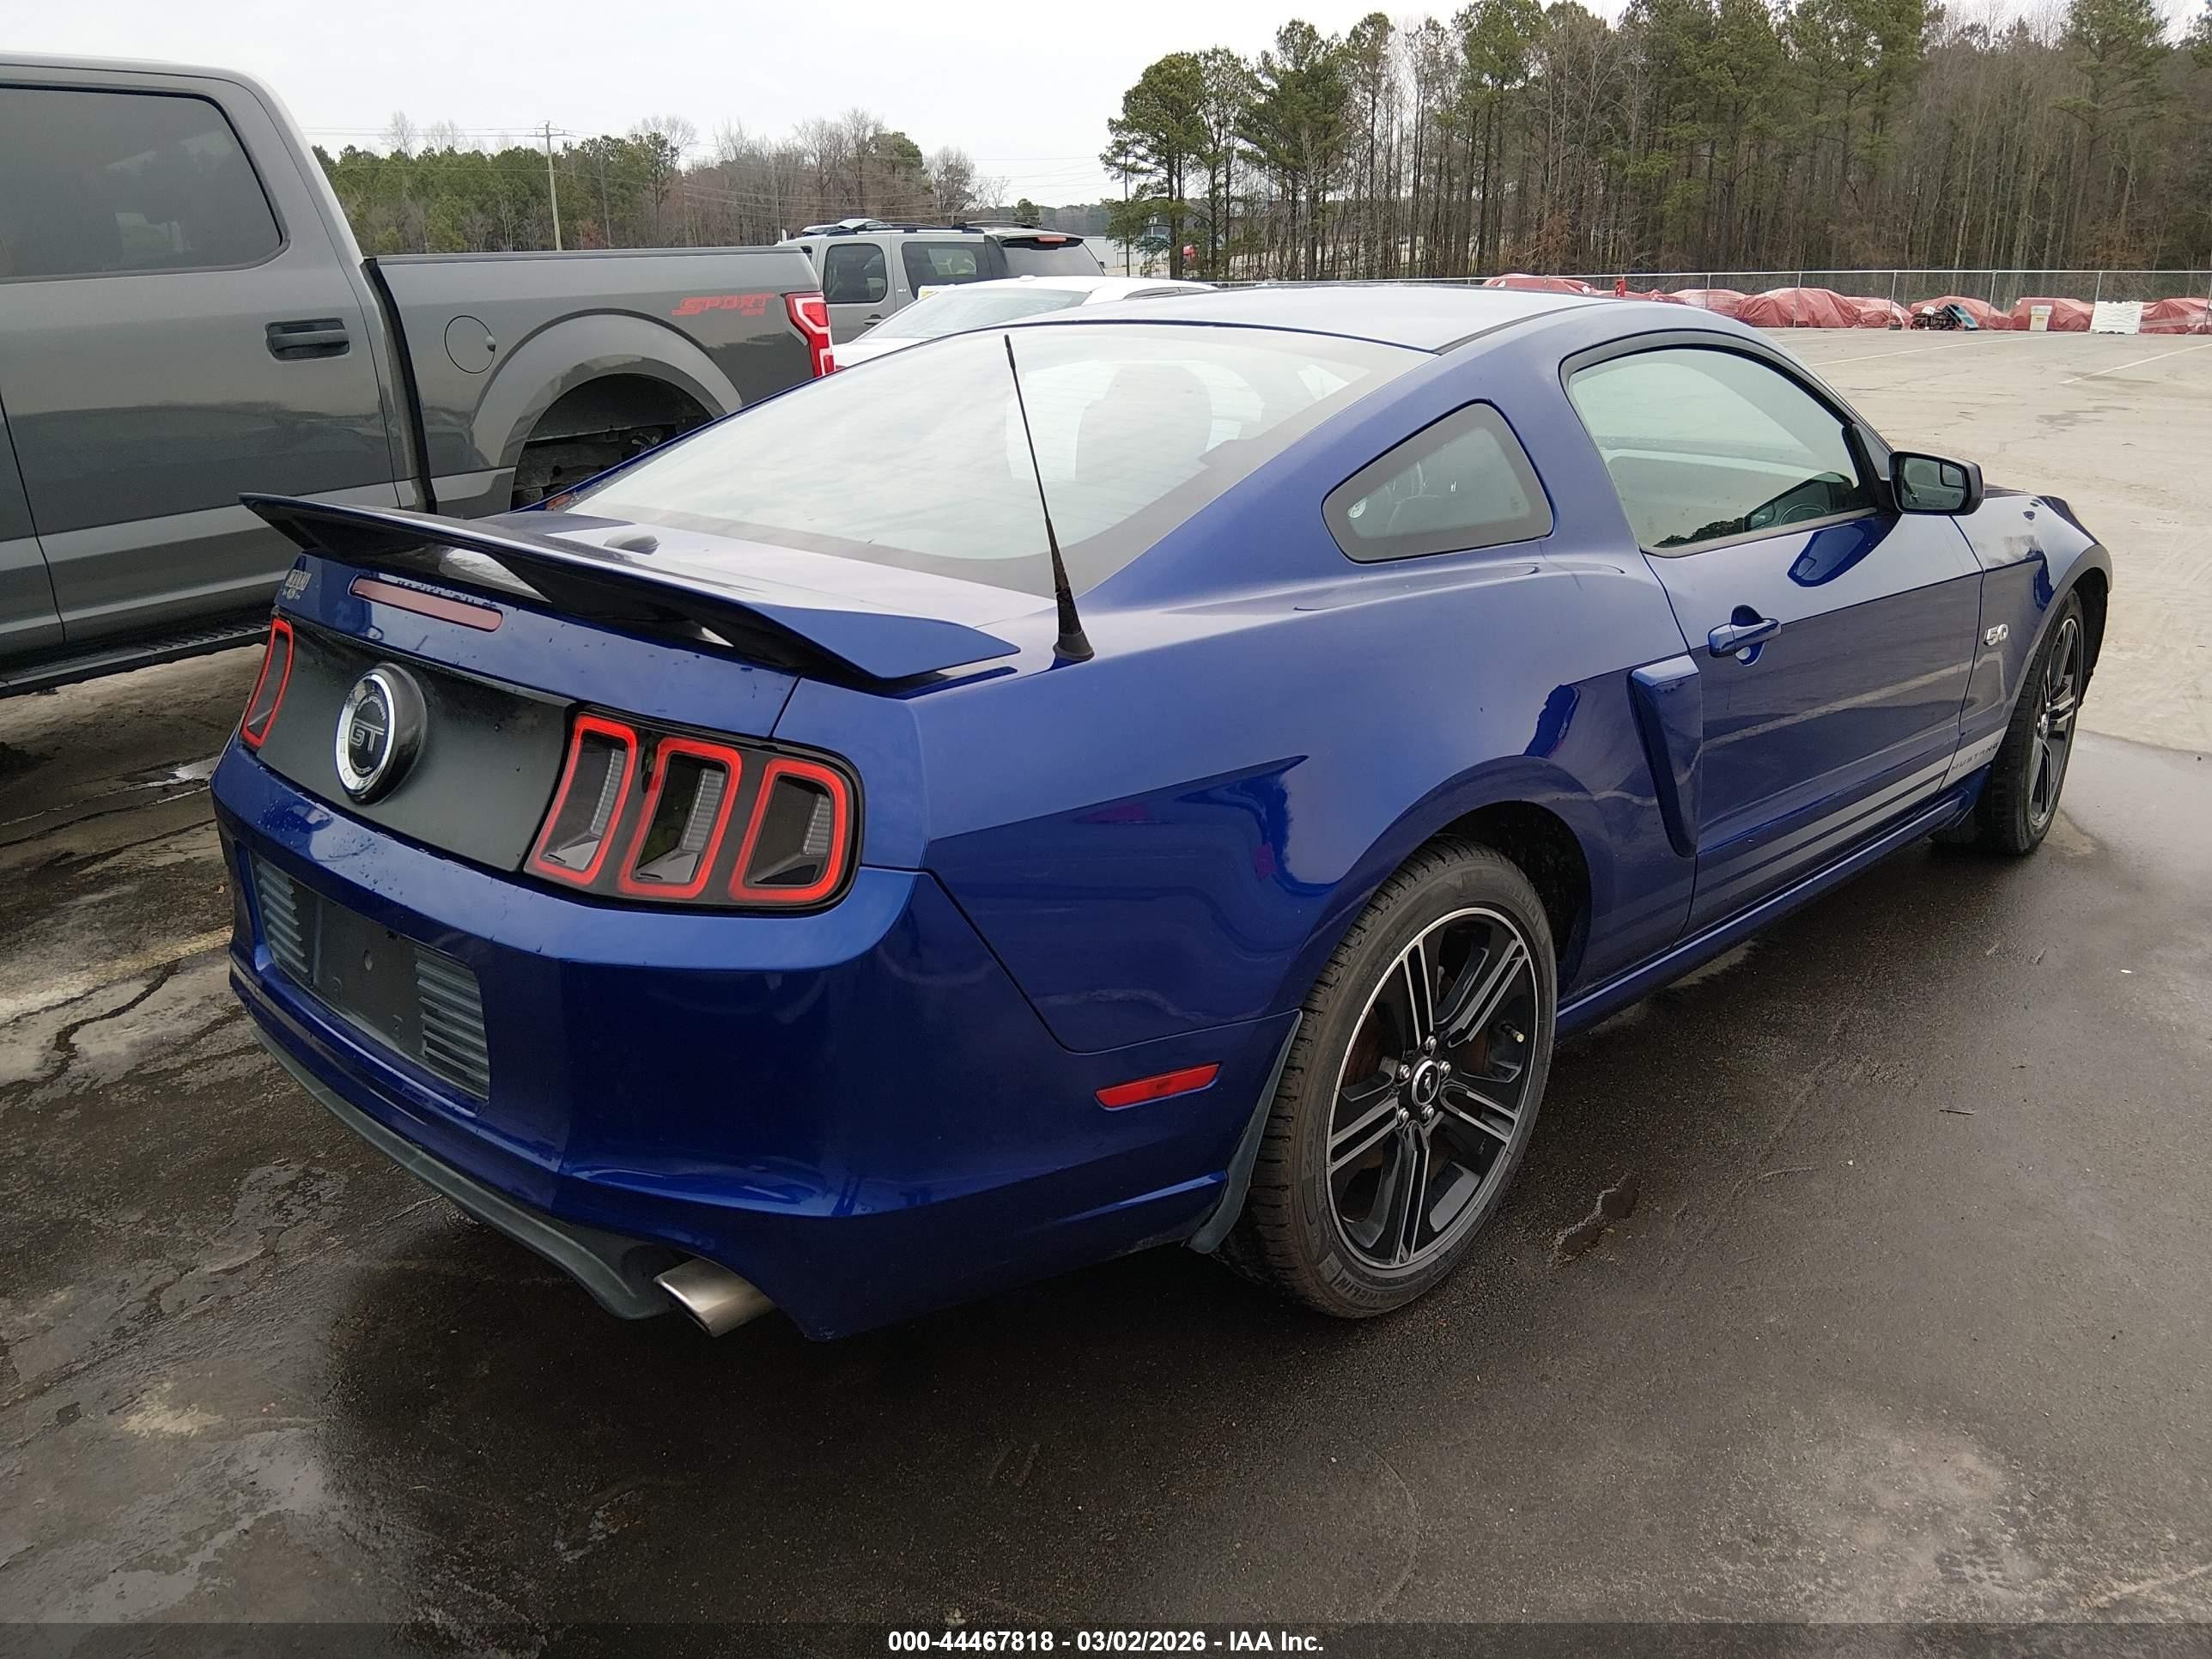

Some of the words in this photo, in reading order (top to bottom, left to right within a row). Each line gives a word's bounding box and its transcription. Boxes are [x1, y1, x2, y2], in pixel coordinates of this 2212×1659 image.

[672, 292, 776, 316] SPORT
[349, 718, 386, 752] GT
[1950, 742, 1999, 771] MUSTANG
